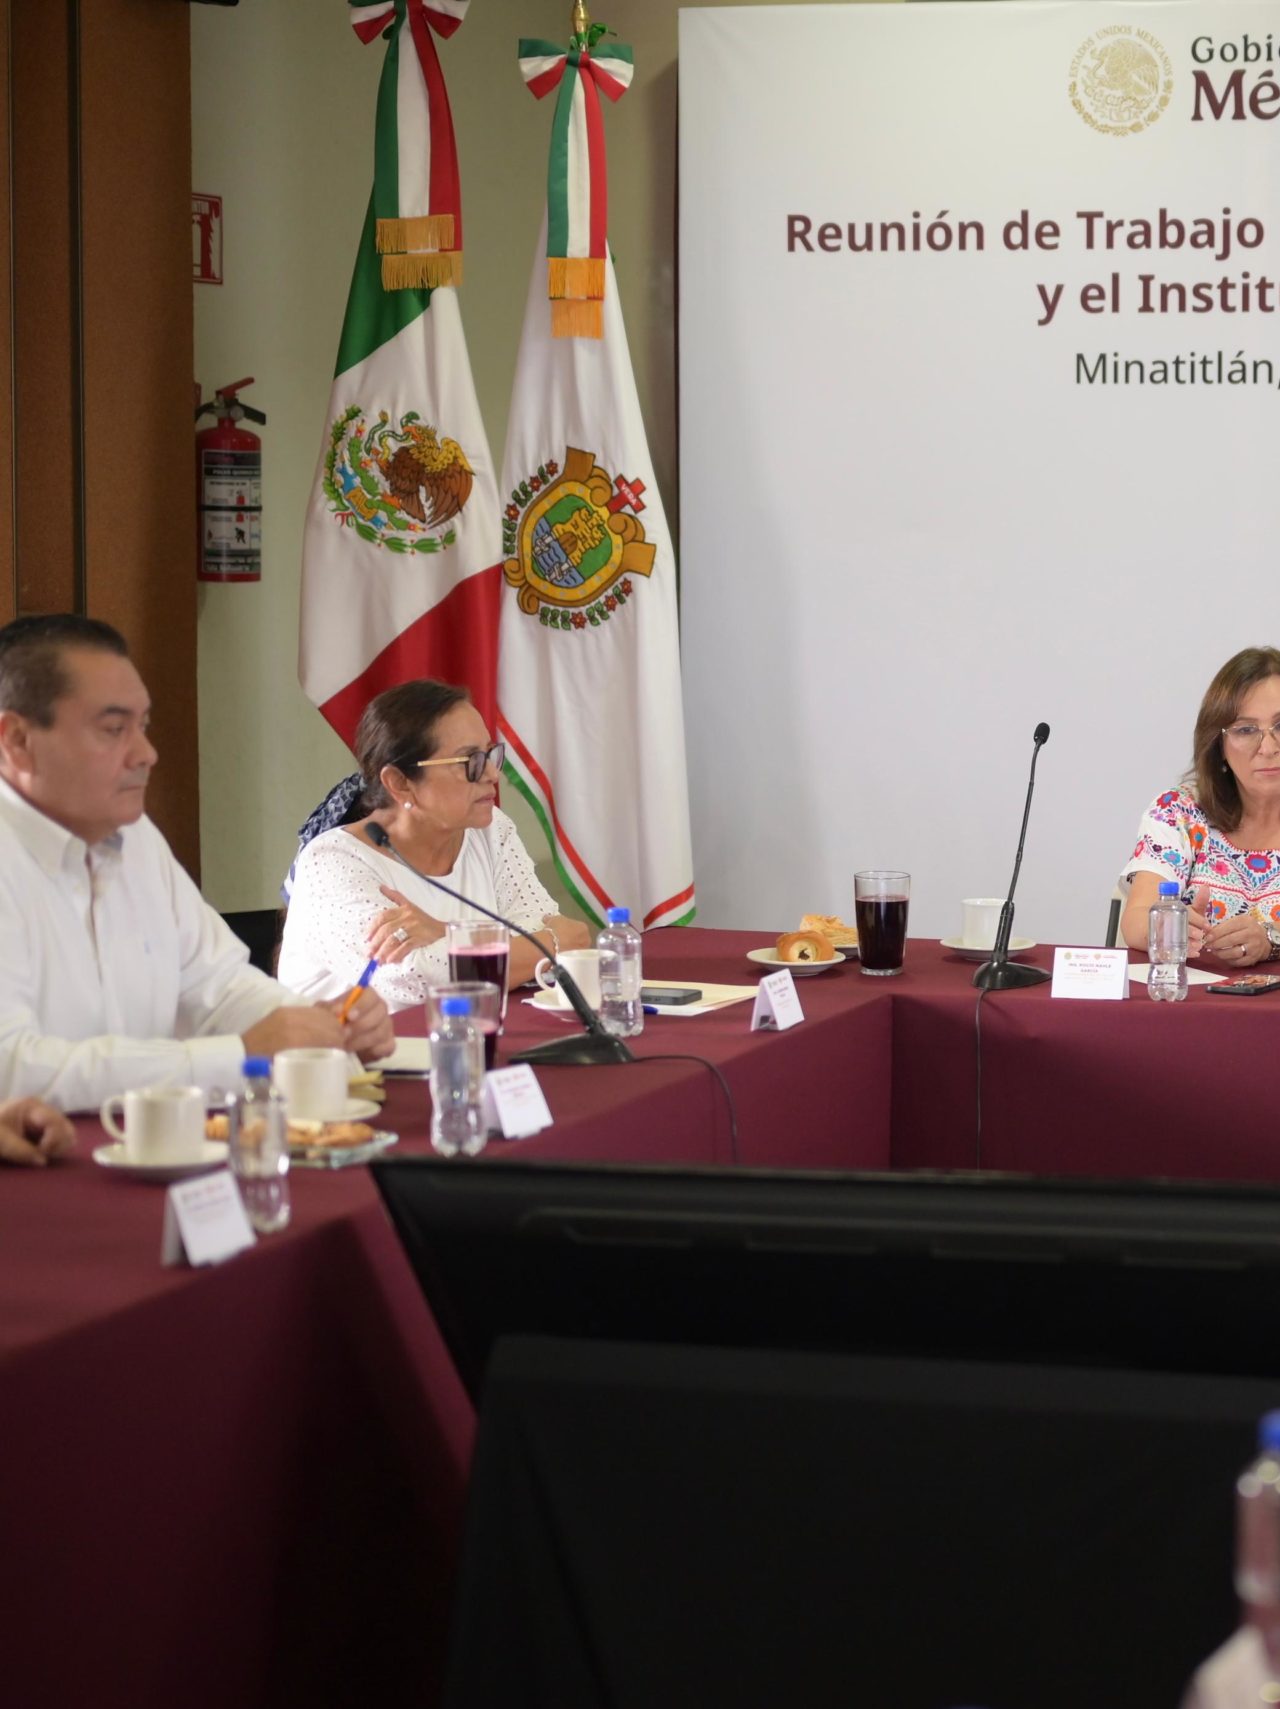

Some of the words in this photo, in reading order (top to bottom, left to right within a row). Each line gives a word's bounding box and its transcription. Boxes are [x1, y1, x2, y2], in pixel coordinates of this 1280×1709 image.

[1096, 25, 1132, 39] UNIDOS
[786, 209, 985, 252] Reunión
[1002, 208, 1061, 252] de
[1076, 206, 1265, 261] Trabajo
[1036, 283, 1065, 326] y
[1079, 271, 1121, 315] el
